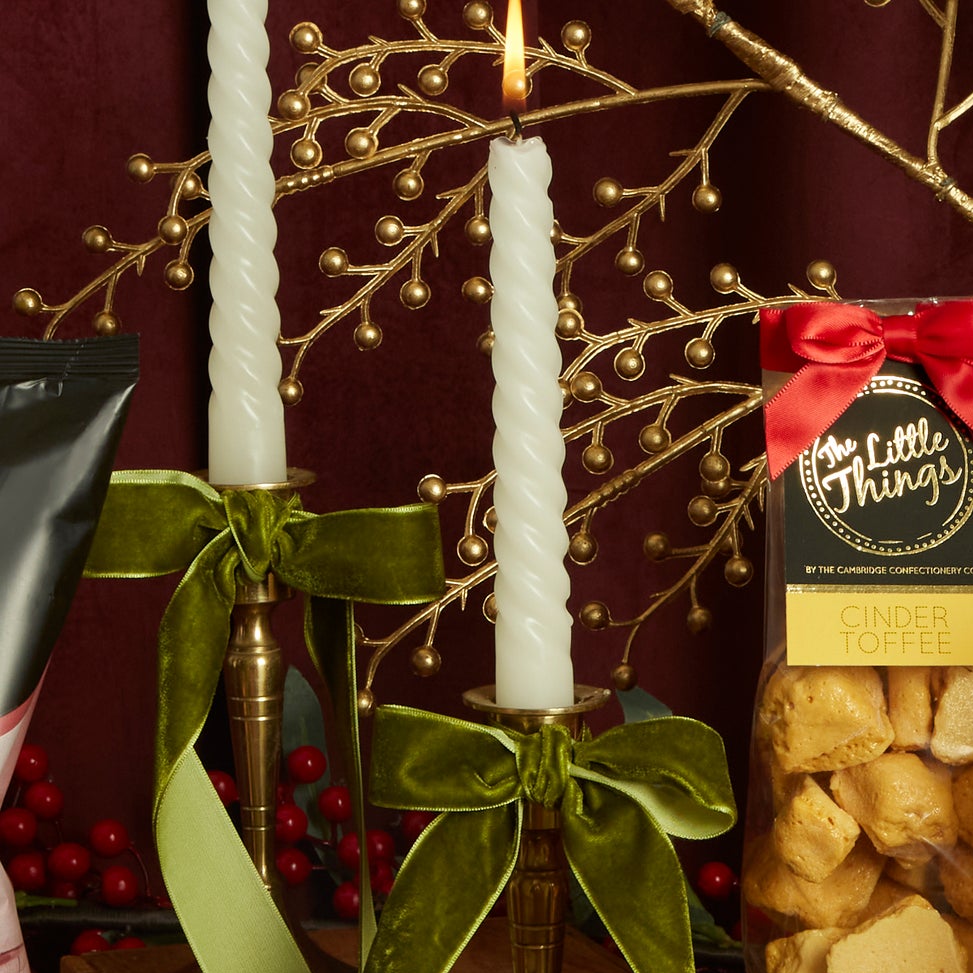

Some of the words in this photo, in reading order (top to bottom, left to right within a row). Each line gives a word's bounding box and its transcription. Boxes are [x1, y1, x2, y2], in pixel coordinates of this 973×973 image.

[818, 432, 858, 468] The
[866, 416, 949, 472] Little
[822, 455, 962, 514] Things
[805, 566, 816, 574] BY
[818, 566, 835, 574] THE
[837, 566, 887, 575] CAMBRIDGE
[890, 566, 961, 575] CONFECTIONERY
[839, 605, 949, 629] CINDER
[839, 632, 952, 654] TOFFEE
